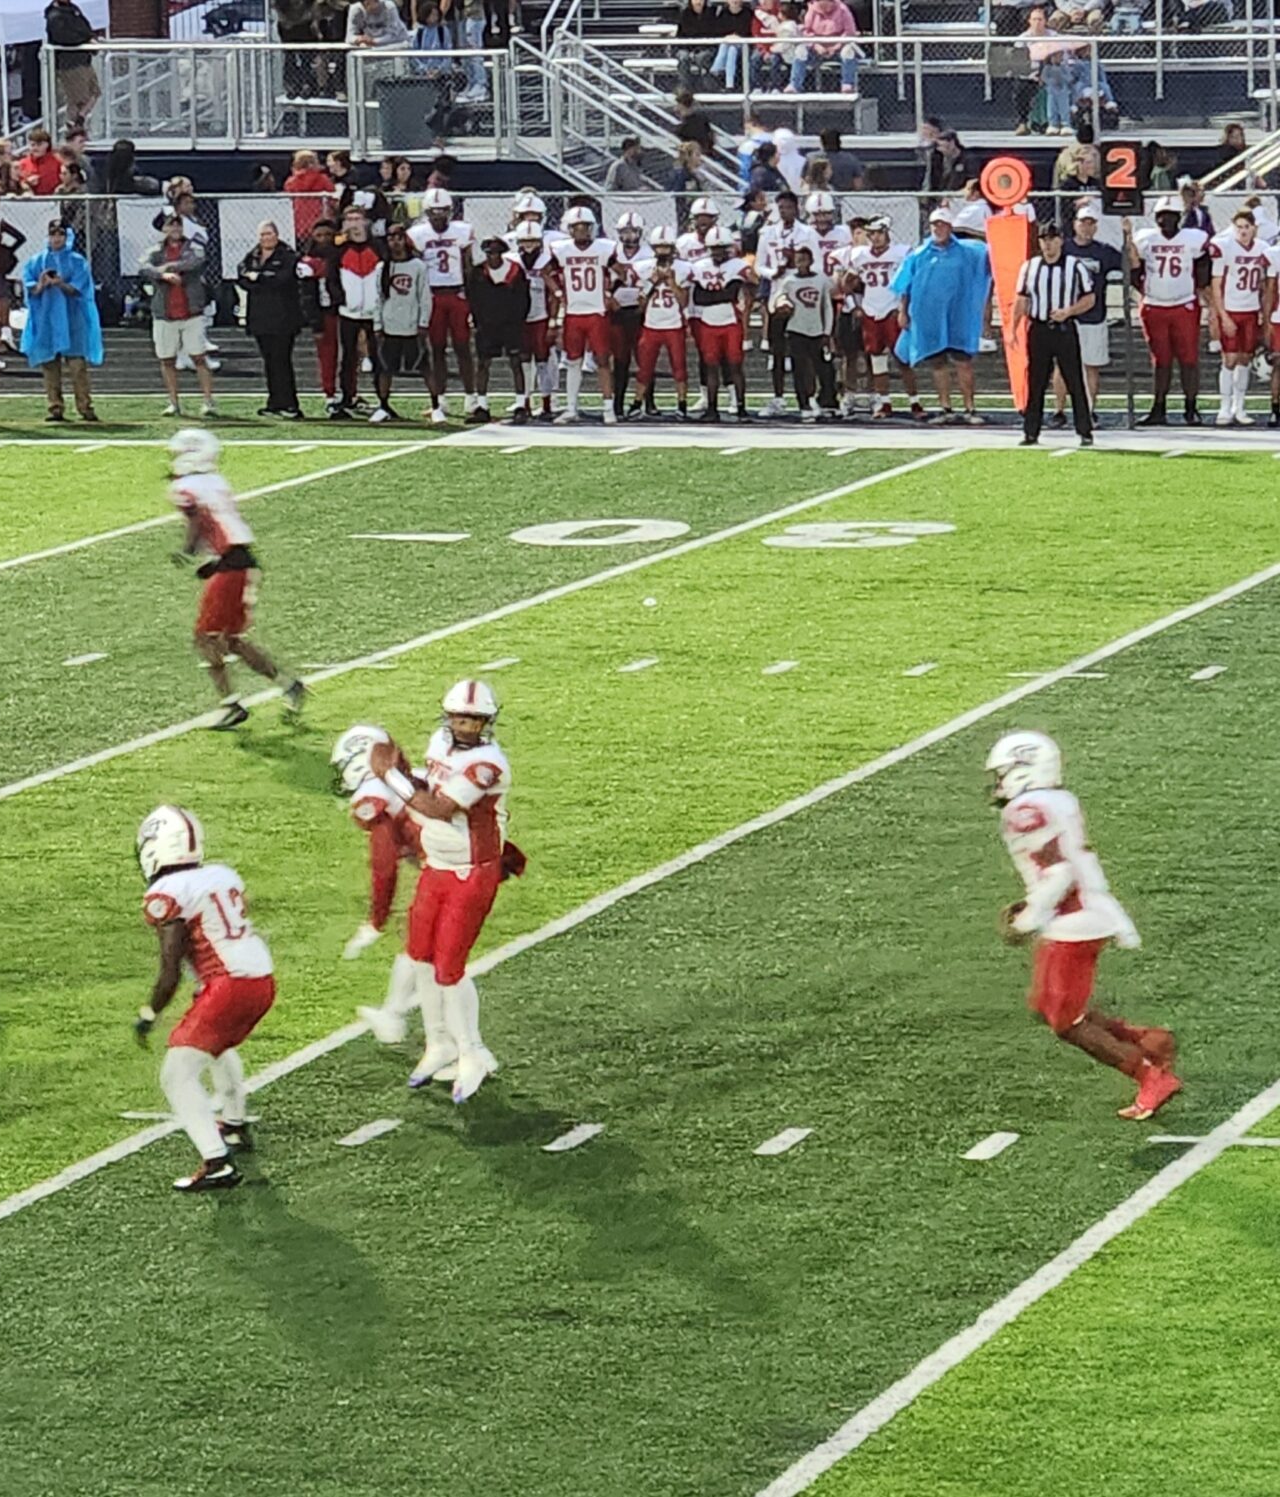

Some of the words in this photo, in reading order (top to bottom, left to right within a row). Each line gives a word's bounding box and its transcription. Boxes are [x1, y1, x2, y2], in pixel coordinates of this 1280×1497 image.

[1105, 147, 1137, 188] 2
[565, 255, 599, 266] NEWPORT
[1155, 256, 1182, 279] 76
[570, 266, 597, 292] 50
[1236, 266, 1261, 292] 30
